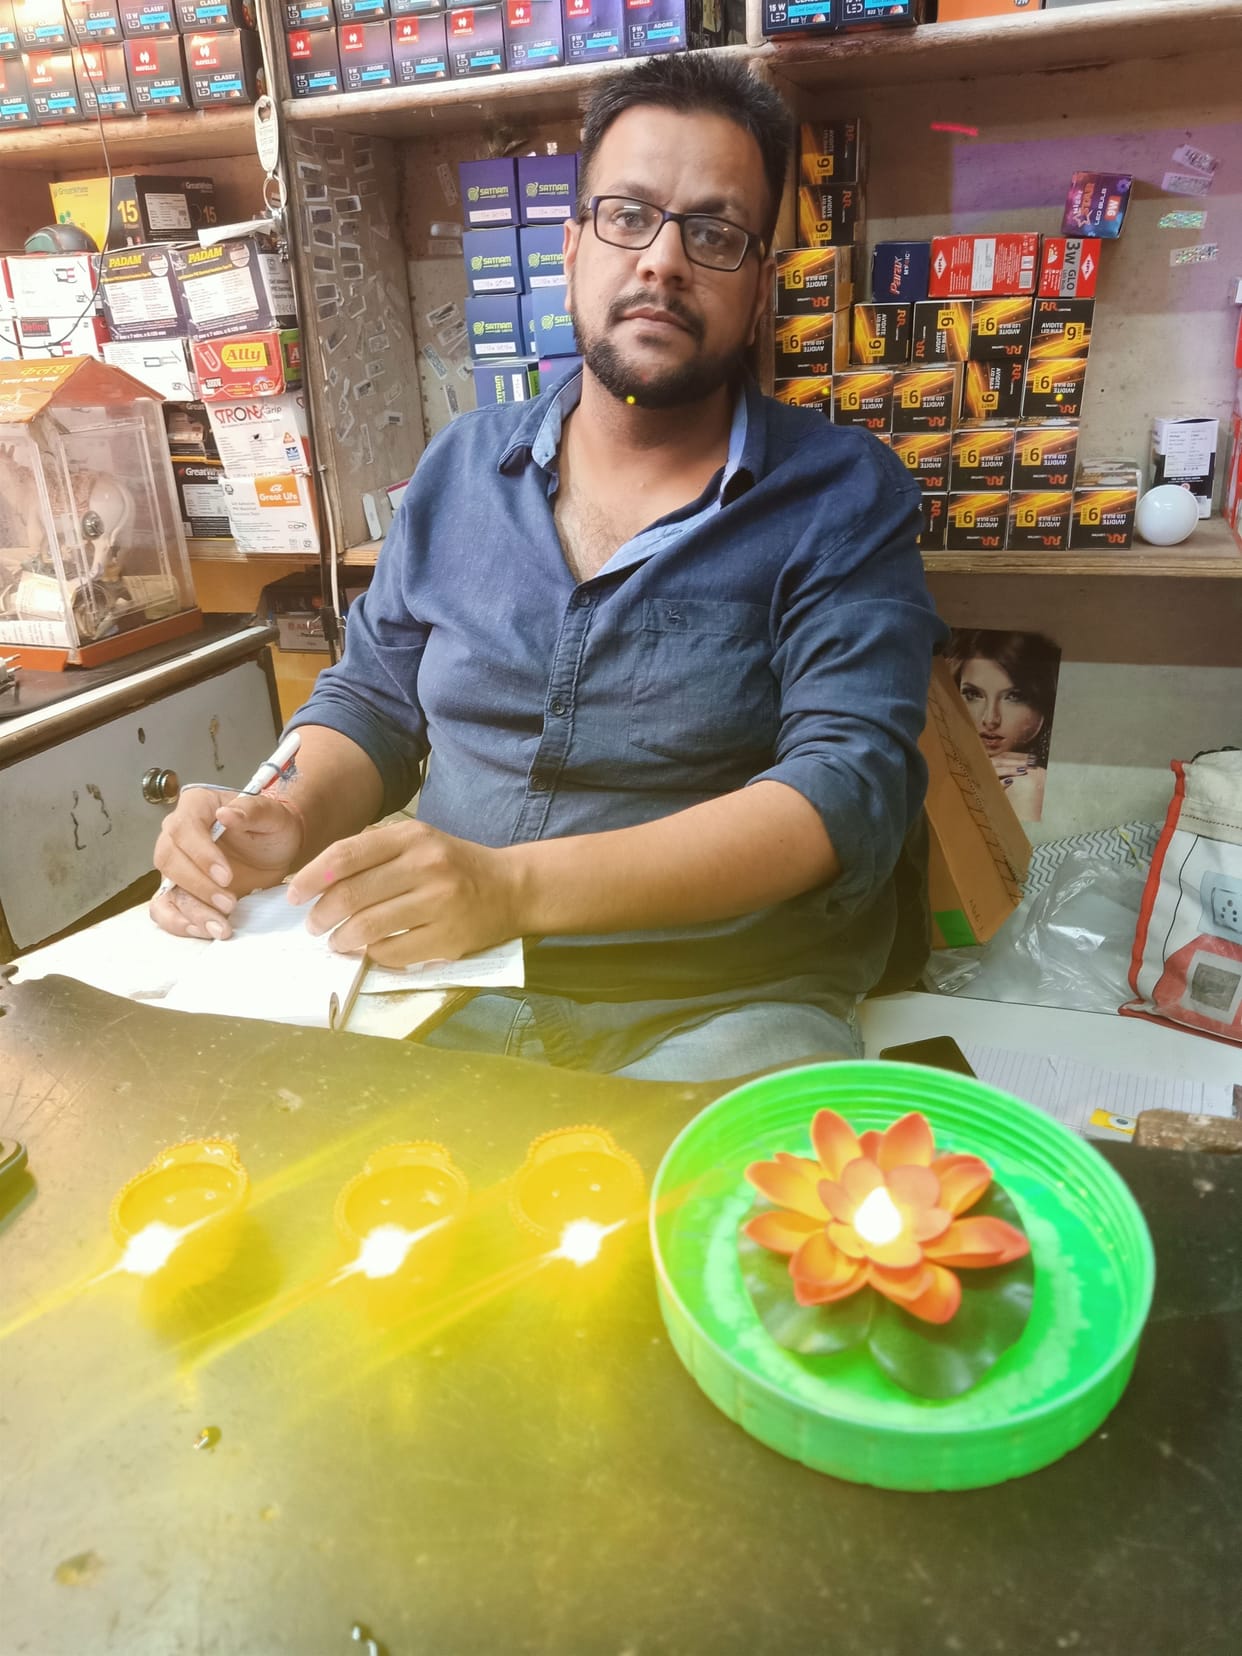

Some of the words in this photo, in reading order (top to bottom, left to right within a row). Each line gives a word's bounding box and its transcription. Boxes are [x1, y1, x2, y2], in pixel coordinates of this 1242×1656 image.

[847, 4, 863, 14] LED
[771, 13, 786, 22] LED
[480, 187, 508, 196] SATNAM
[539, 184, 569, 192] SATNAM
[1082, 184, 1096, 215] STAR
[1098, 188, 1107, 210] BULB
[118, 200, 140, 224] 15
[1107, 200, 1119, 216] 9W
[204, 207, 217, 224] 15
[816, 223, 829, 233] 9
[109, 255, 142, 268] PADAM
[188, 247, 223, 264] PADAM
[483, 256, 512, 264] SATNAM
[793, 270, 801, 285] 9
[1067, 270, 1076, 290] GLO
[1040, 302, 1057, 311] RR
[897, 309, 907, 327] RR
[941, 317, 954, 327] 9
[986, 318, 995, 331] 9
[485, 322, 513, 330] SATNAM
[1067, 327, 1077, 340] 9
[790, 335, 799, 349] 9
[869, 340, 881, 349] 9
[916, 340, 925, 357] RR
[227, 349, 261, 363] Ally
[1005, 345, 1023, 355] RR
[811, 363, 828, 373] RR
[1012, 364, 1022, 382] RR
[1041, 376, 1050, 389] 9
[849, 392, 858, 406] 9
[910, 390, 919, 404] 9
[982, 394, 994, 403] 9
[1059, 405, 1077, 413] RR
[867, 418, 886, 428] RR
[928, 417, 946, 427] RR
[907, 451, 916, 465] 9
[968, 450, 977, 463] 9
[1030, 448, 1039, 462] 9
[925, 477, 944, 487] RR
[986, 476, 1005, 486] RR
[1049, 475, 1068, 484] RR
[284, 493, 298, 501] Life
[932, 500, 942, 517] RR
[1089, 508, 1098, 521] 9
[964, 511, 973, 524] 9
[1025, 510, 1034, 523] 9
[1042, 536, 1061, 546] RR
[1108, 534, 1127, 543] RR
